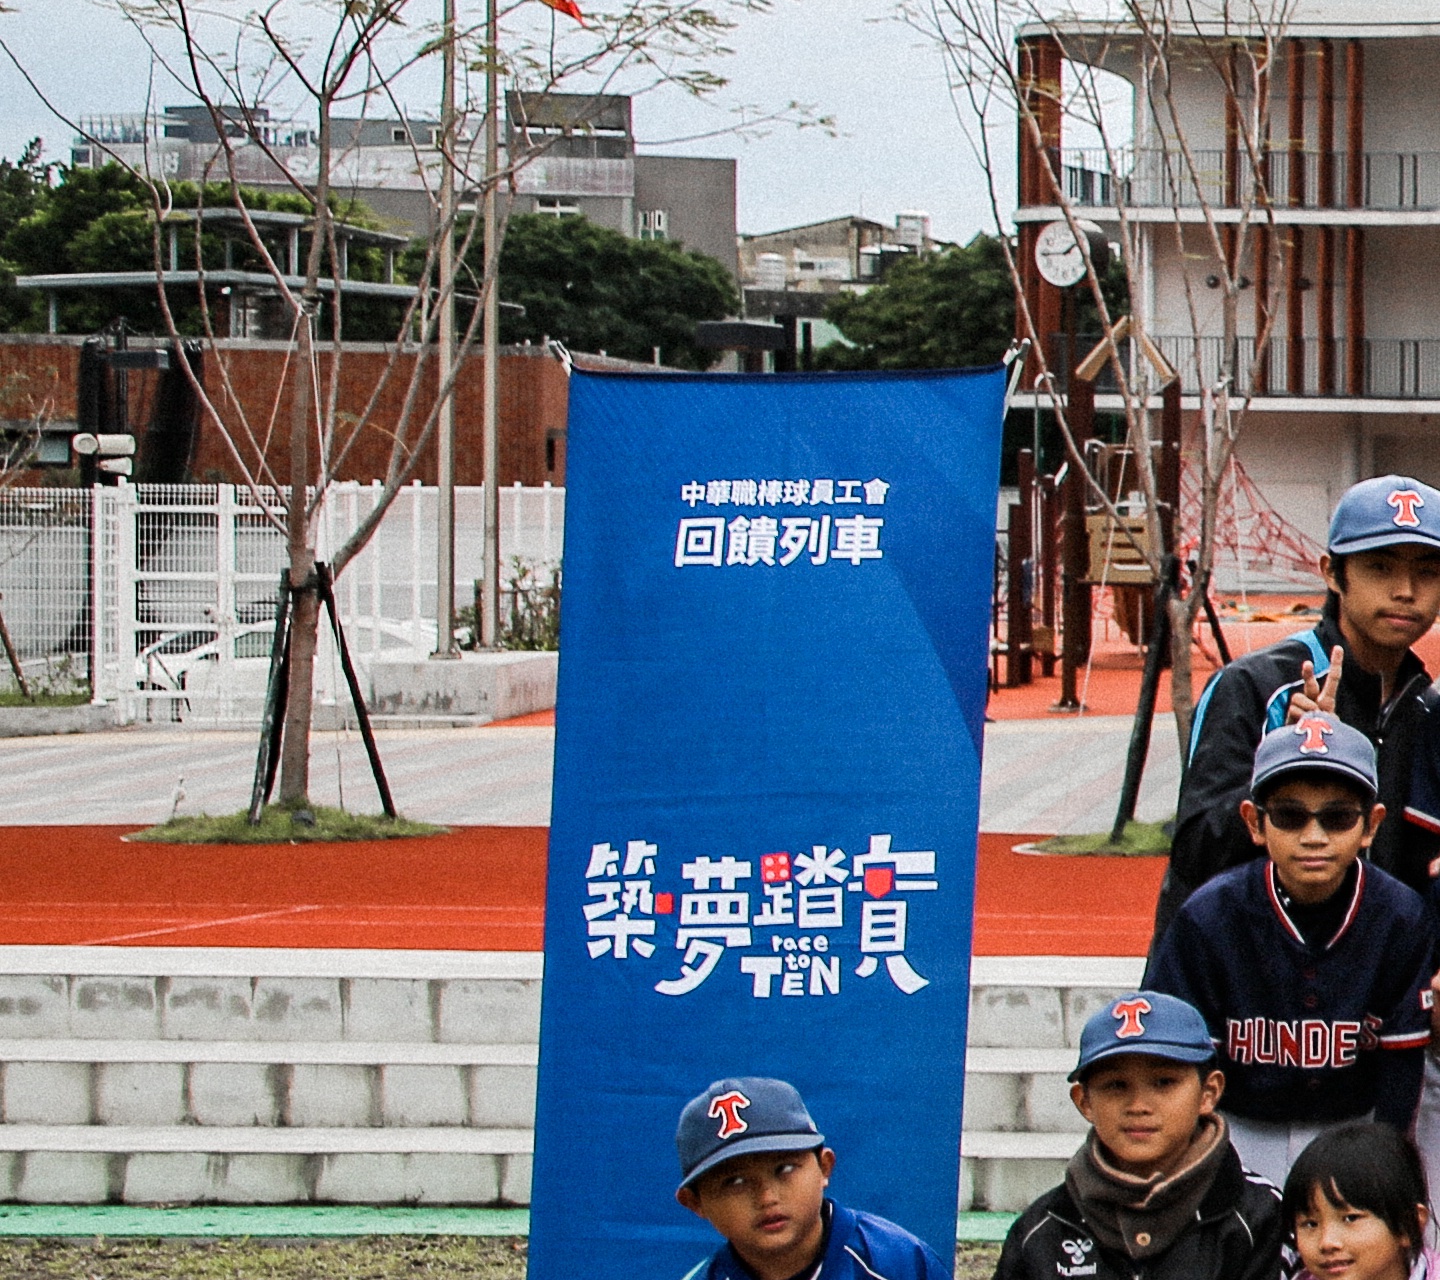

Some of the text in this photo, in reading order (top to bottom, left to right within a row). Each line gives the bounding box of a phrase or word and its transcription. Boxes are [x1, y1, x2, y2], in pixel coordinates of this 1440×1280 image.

[680, 477, 890, 507] 中華職棒球員工會
[1387, 490, 1424, 527] T
[674, 515, 883, 568] 回饋列車
[1296, 716, 1333, 753] T
[771, 932, 829, 953] race
[740, 956, 841, 998] TEN
[785, 953, 811, 971] to
[1111, 998, 1153, 1039] T
[707, 1090, 752, 1140] T
